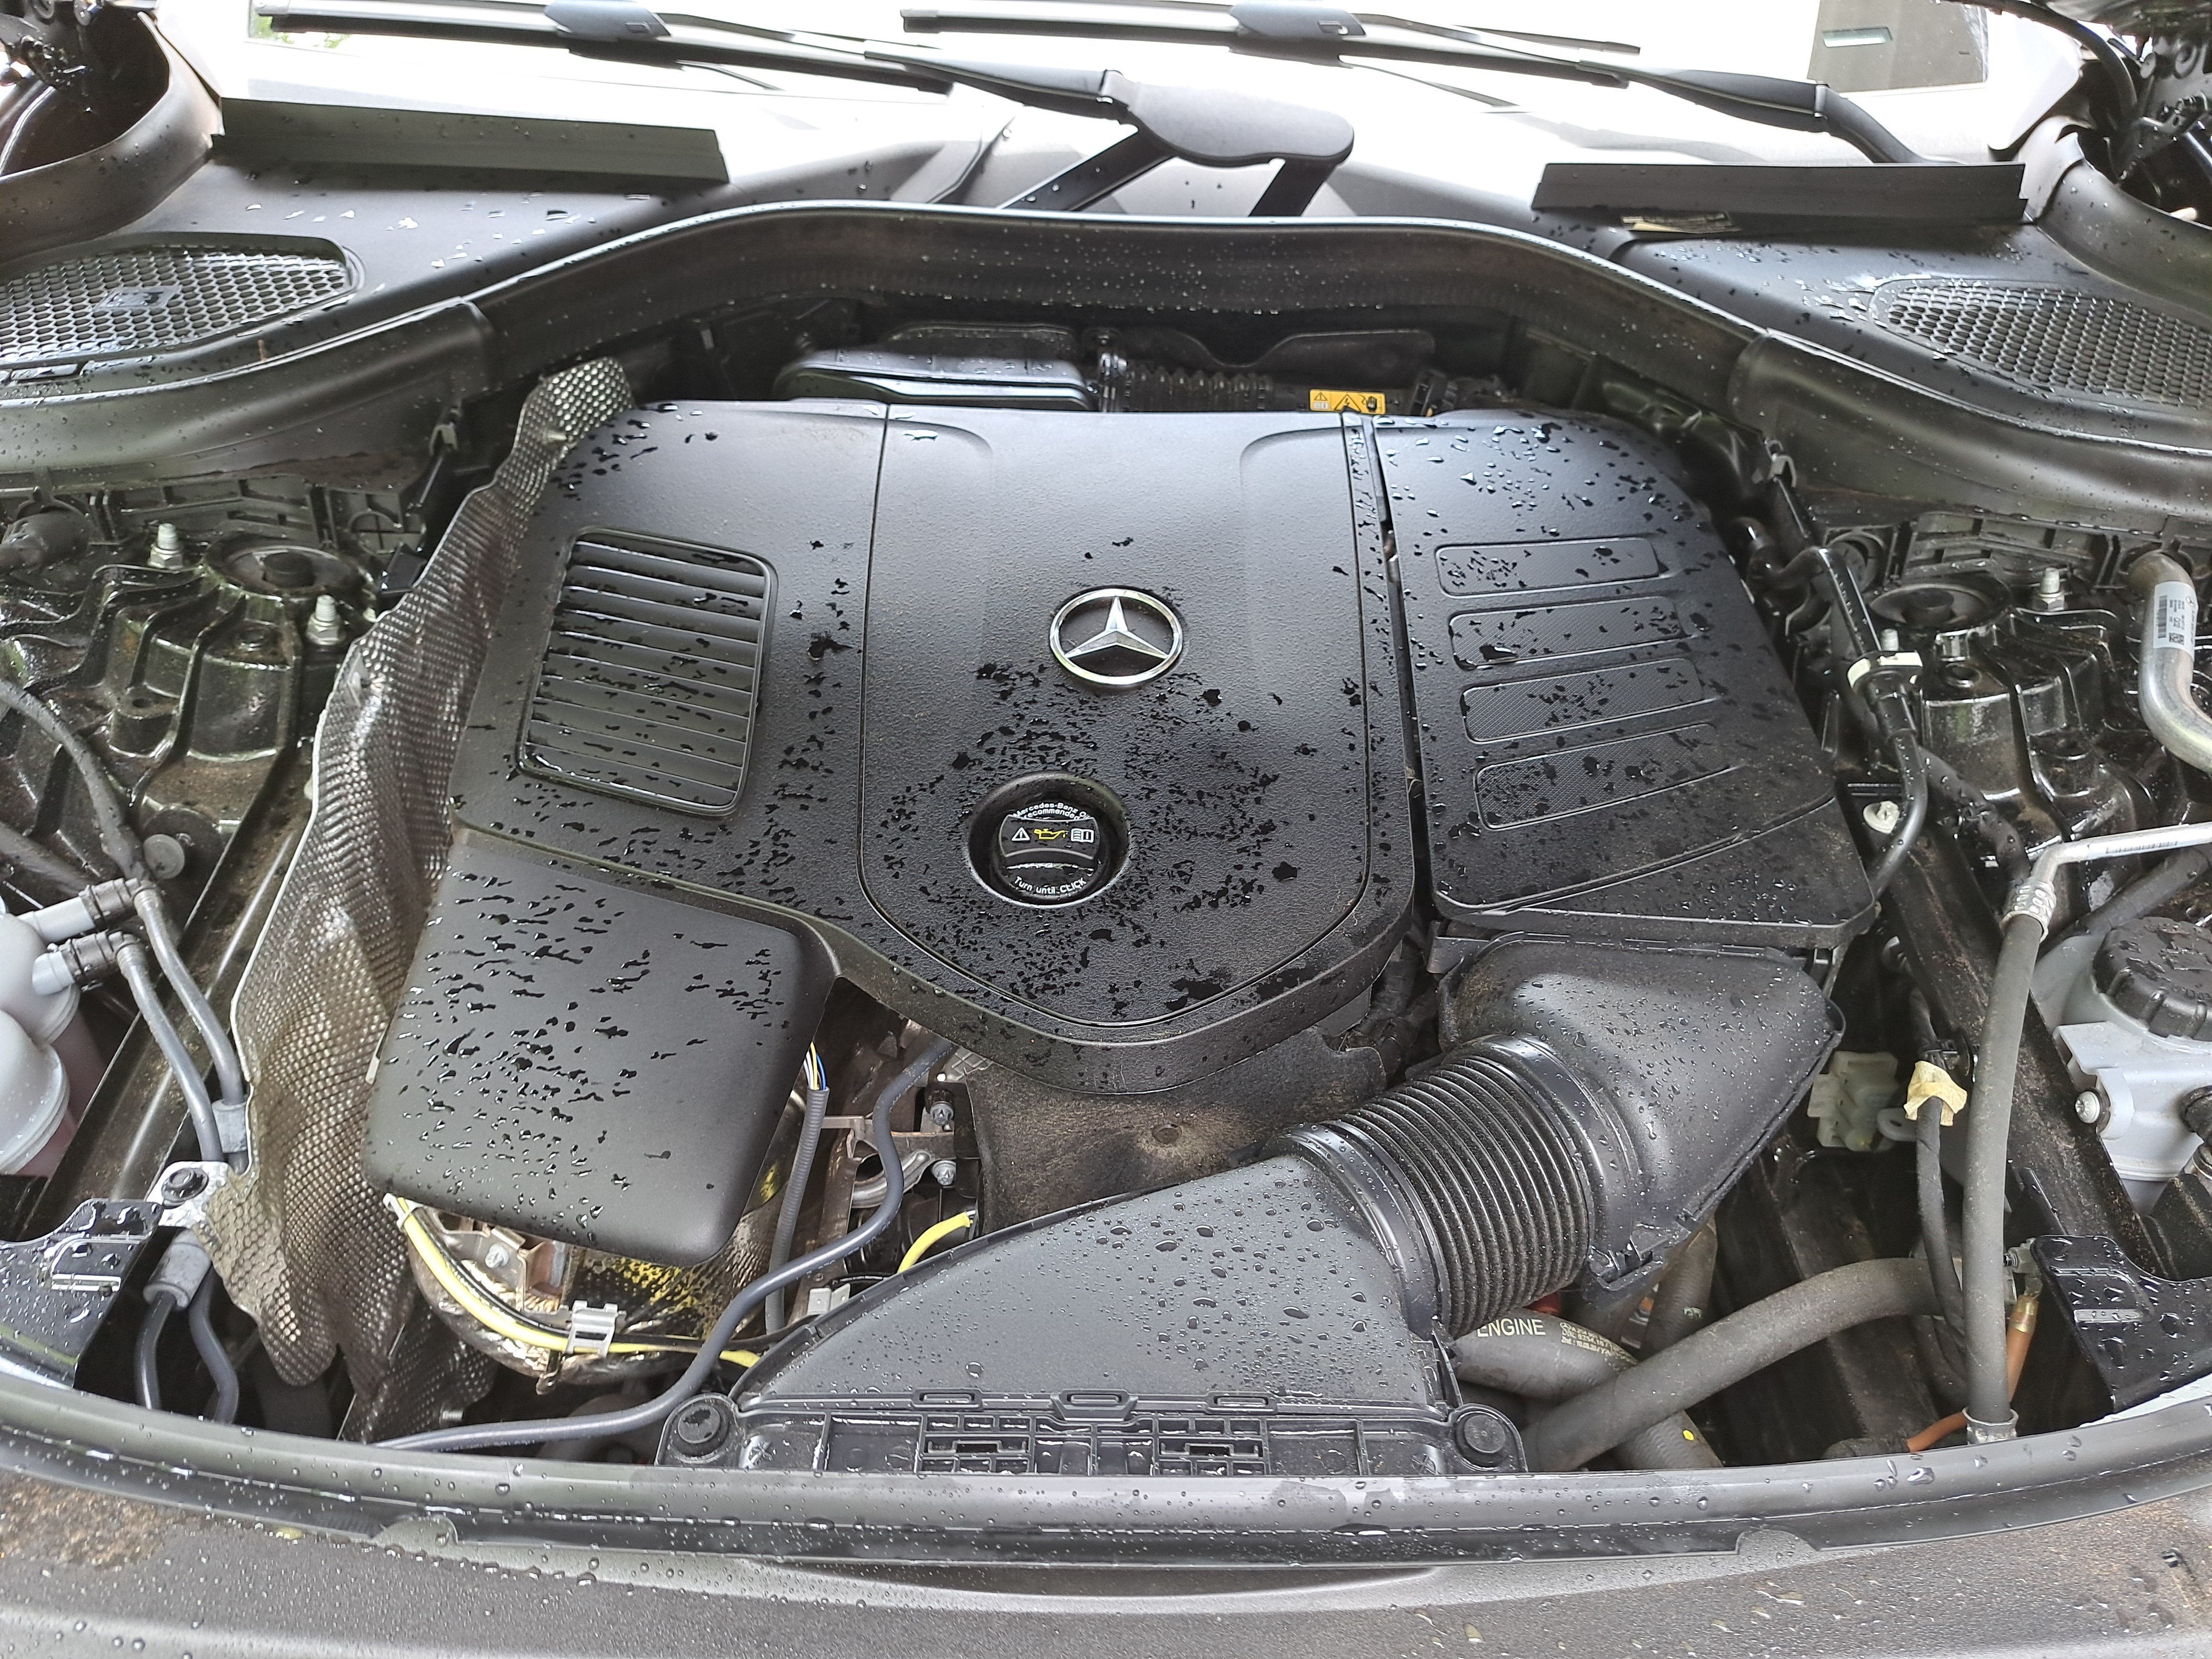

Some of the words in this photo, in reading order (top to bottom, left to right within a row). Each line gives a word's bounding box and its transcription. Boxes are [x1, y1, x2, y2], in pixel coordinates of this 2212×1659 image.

[1013, 802, 1079, 818] Mercedes-Benz
[1014, 876, 1032, 891] Turn
[1036, 886, 1055, 894] until
[1060, 877, 1086, 893] CLICK
[1477, 1318, 1546, 1337] ENGINE
